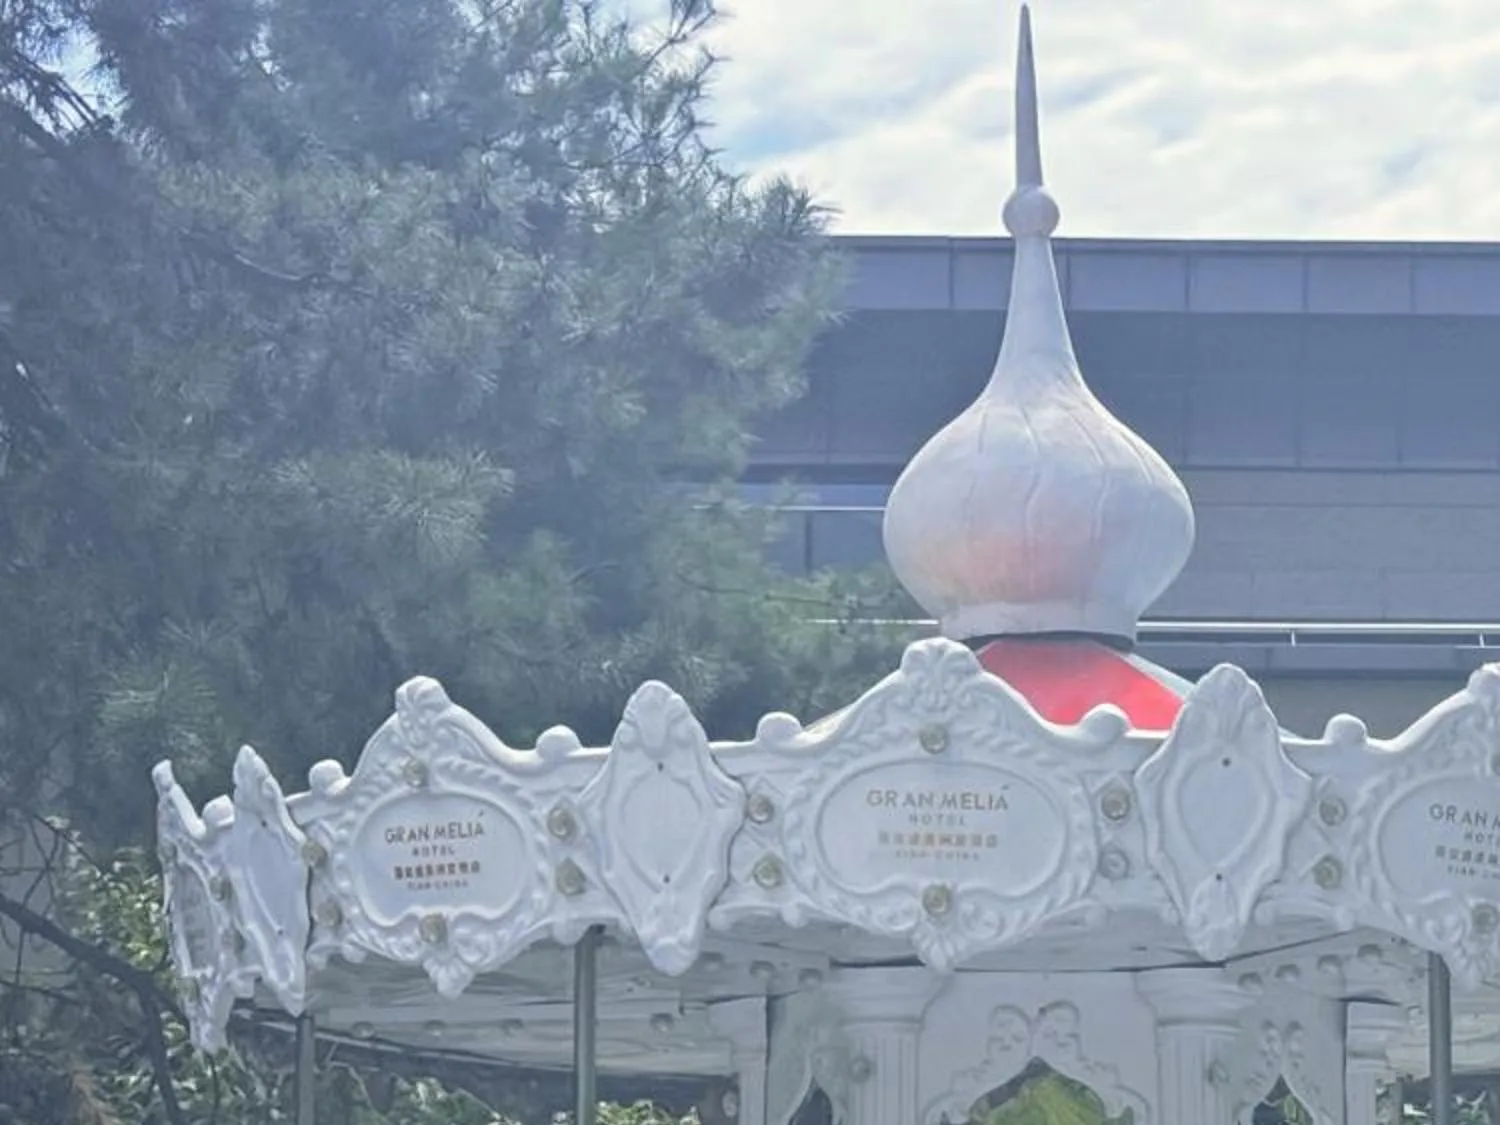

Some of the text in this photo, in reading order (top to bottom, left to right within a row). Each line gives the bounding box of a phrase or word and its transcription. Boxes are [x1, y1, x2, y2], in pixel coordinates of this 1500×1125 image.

[866, 789, 934, 808] GRAN
[1429, 803, 1488, 828] GRAN
[384, 823, 429, 843] GRAN
